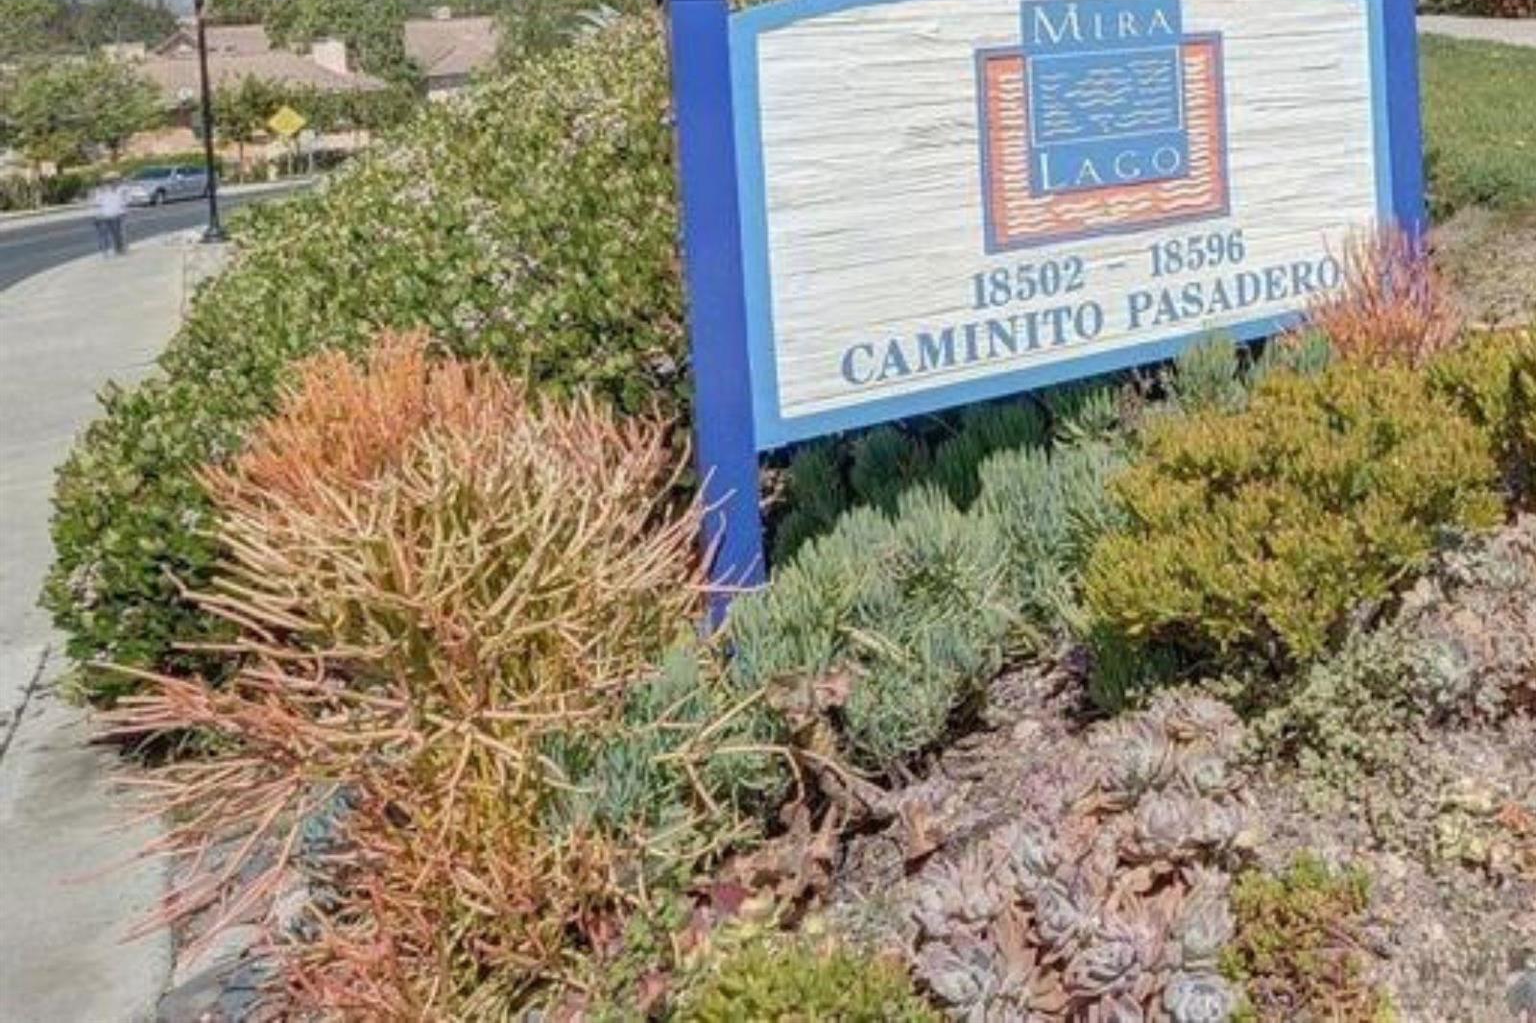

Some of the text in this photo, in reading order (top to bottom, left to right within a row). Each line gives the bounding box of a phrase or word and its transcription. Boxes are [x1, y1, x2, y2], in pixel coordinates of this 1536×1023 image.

[1033, 2, 1174, 45] MIRA
[1039, 146, 1181, 191] LAGO
[972, 255, 1084, 311] 18502
[1149, 229, 1247, 278] 18596
[841, 255, 1341, 385] CAMINITO PASADERO
